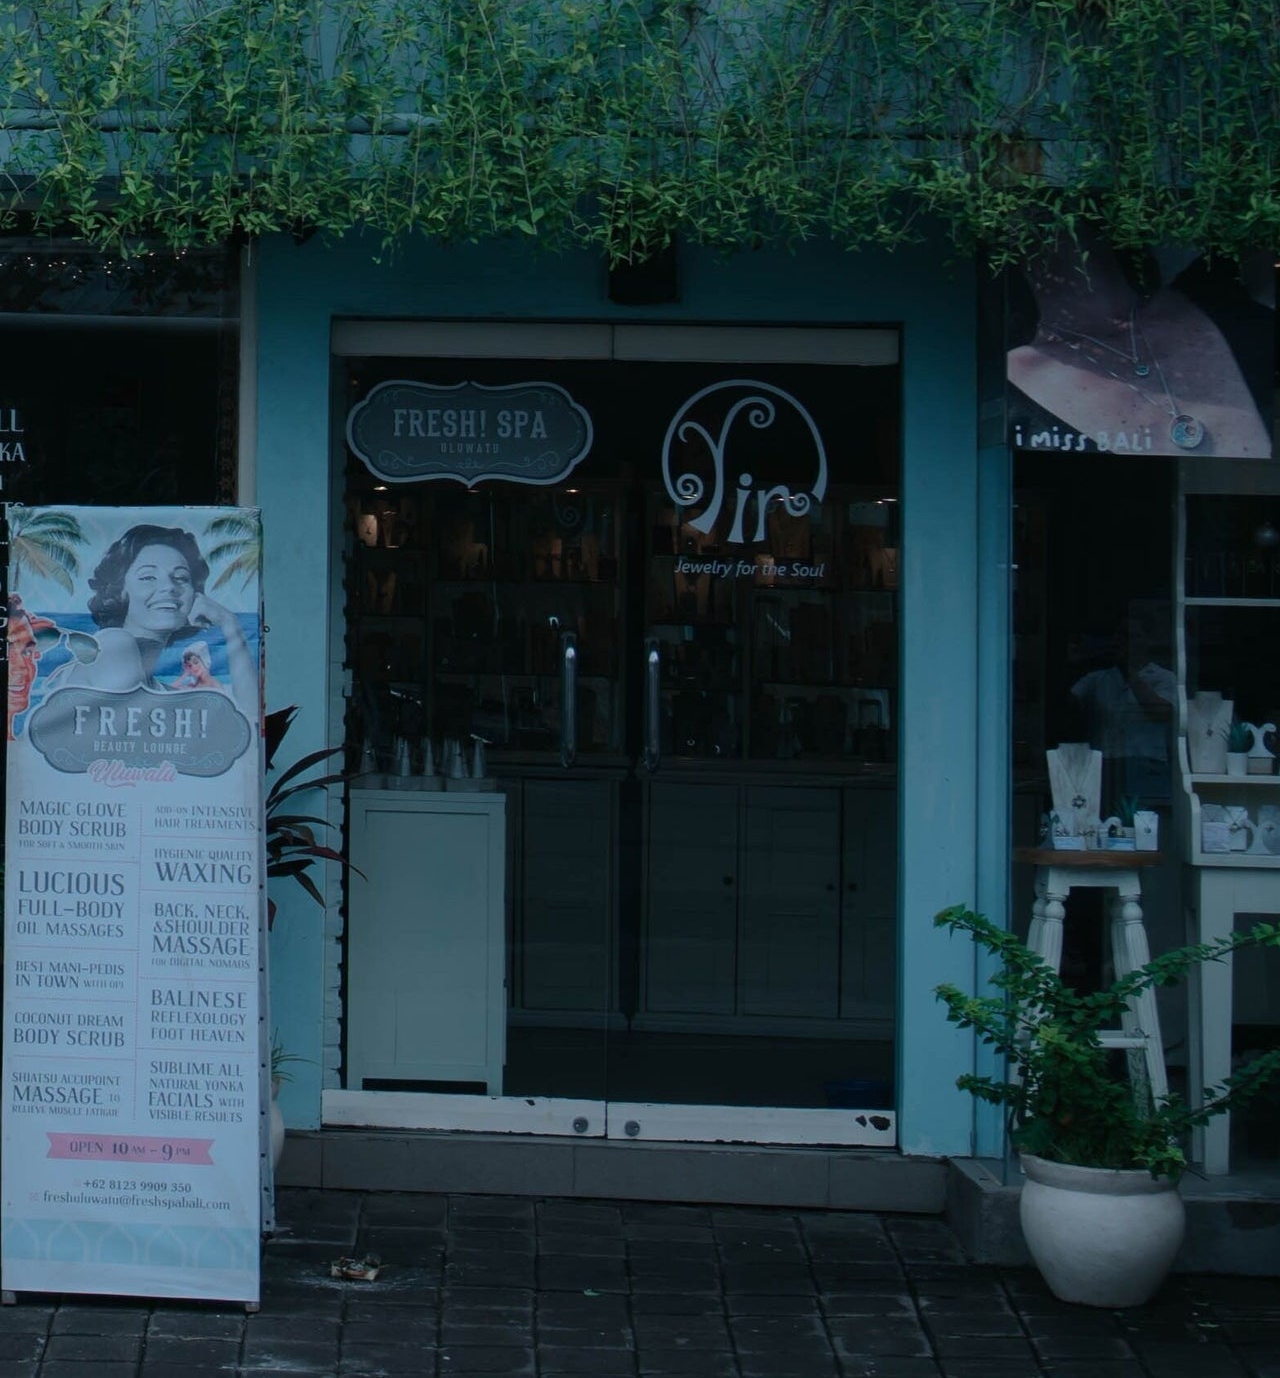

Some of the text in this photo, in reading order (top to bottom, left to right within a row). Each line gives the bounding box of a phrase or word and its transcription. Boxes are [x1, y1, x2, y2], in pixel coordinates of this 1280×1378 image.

[392, 409, 548, 439] FRESH! SPA
[440, 442, 500, 454] ULUWATU
[674, 558, 826, 578] Jewelry for the Soul
[73, 705, 209, 738] FRESH!
[93, 740, 187, 755] BEAUTY LOUNGE
[90, 759, 177, 787] Uluwatu
[19, 800, 127, 818] MAGIC GLOVE
[191, 805, 253, 819] INTENSIVE
[18, 819, 126, 838] BODY SCRUB
[154, 817, 256, 831] HAIR TREATMENTS
[19, 839, 34, 848] FOR
[154, 848, 253, 862] HYGIENIC QUALITY
[155, 862, 252, 885] WAXING
[19, 871, 125, 896] LUCIOUS
[18, 898, 125, 919] FULL-BODY
[16, 921, 124, 938] OIL MASSAGES
[152, 935, 250, 956] MASSAGE
[15, 960, 125, 976] BEST MANI-PEDIS
[209, 959, 251, 970] NOMADS
[15, 973, 31, 987] IN
[37, 974, 80, 989] TOWN
[151, 989, 248, 1009] BALINESE
[14, 1011, 125, 1028] COCONUT DREAM
[151, 1010, 247, 1026] REFLEXOLOGY
[13, 1028, 126, 1047] BODY SCRUB
[151, 1027, 245, 1043] FOOT HEAVEN
[150, 1060, 244, 1077] SUBLIME ALL
[11, 1071, 121, 1087] SHIATSU ACCUPOINT
[149, 1077, 245, 1092] NATURAL YONKA
[12, 1085, 121, 1105] MASSAGE TO
[148, 1091, 245, 1109] FACIALS WITH
[149, 1109, 244, 1123] VISIBLE RESULTS
[69, 1140, 104, 1153] OPEN
[111, 1141, 129, 1155] 10
[161, 1143, 173, 1161] 9
[83, 1178, 192, 1193] +62 8123 9909 350
